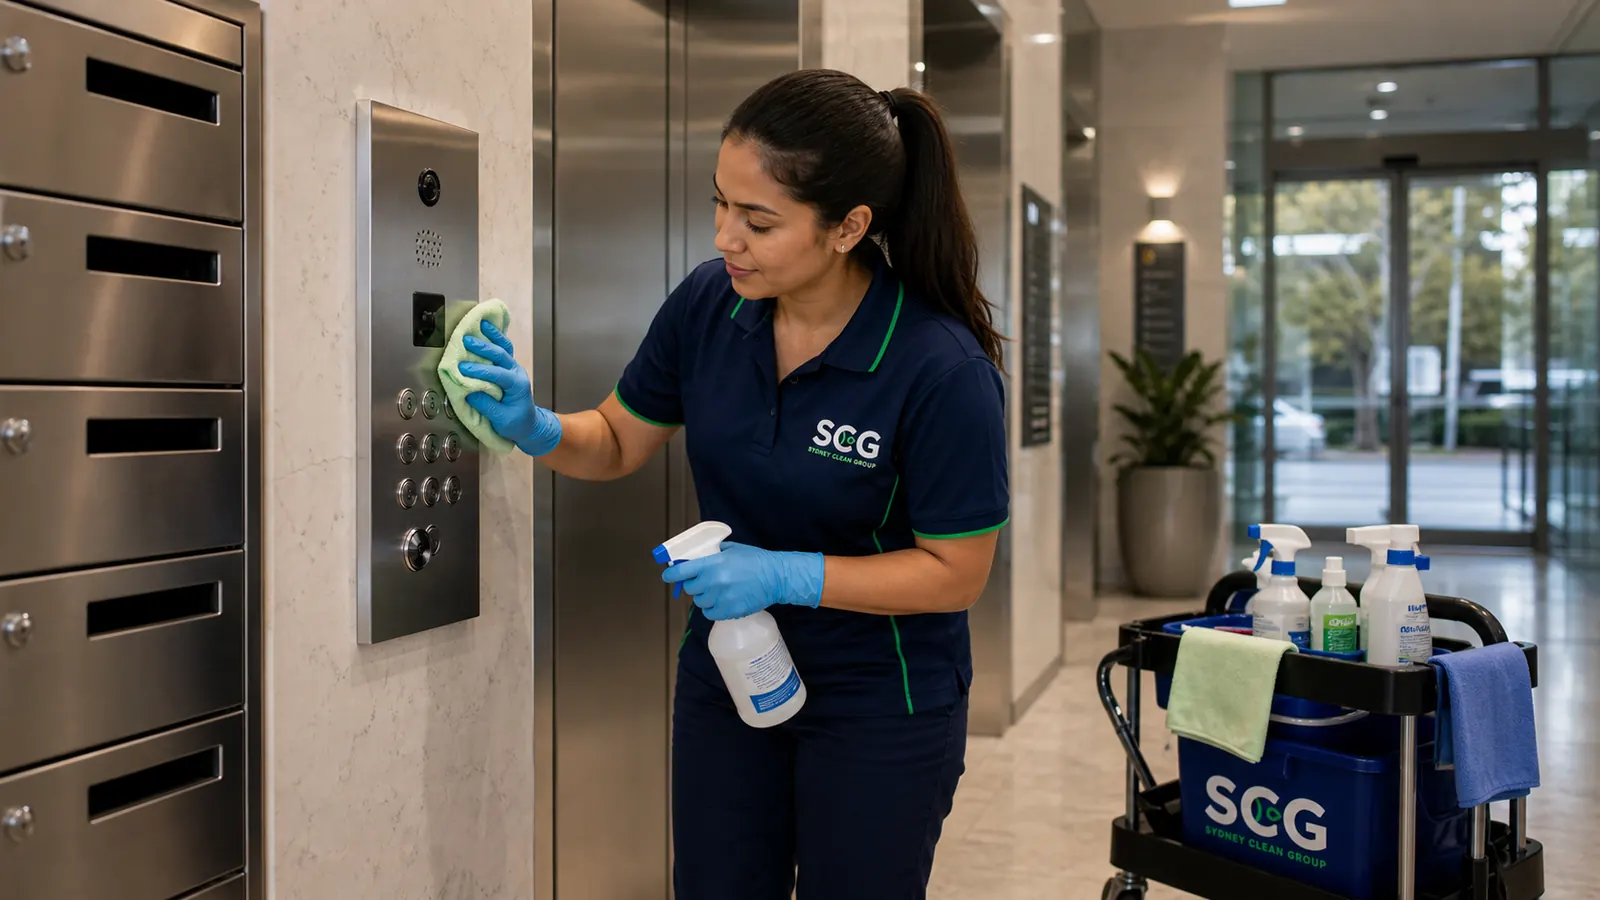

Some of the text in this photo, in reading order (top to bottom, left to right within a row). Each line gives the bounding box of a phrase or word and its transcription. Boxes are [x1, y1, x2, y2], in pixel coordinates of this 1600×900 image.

[807, 446, 876, 468] SYDNEY CLEAN GROUP
[812, 419, 881, 459] SCG
[1205, 775, 1327, 851] SCG
[1205, 825, 1327, 868] SYDNEY CLEAN GROUP
